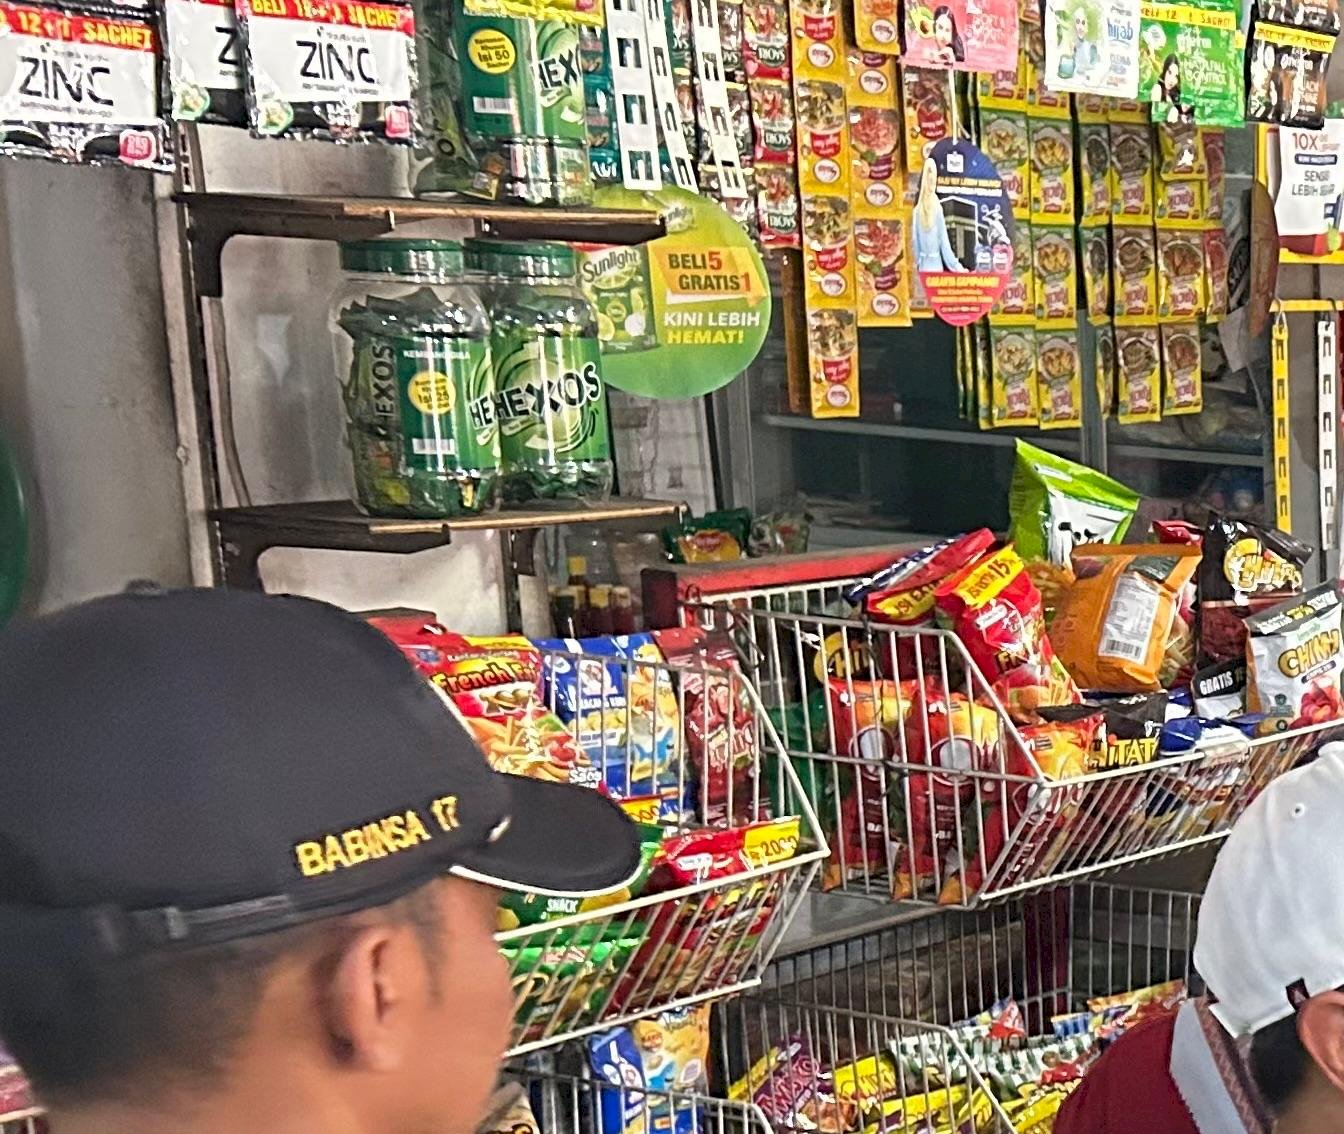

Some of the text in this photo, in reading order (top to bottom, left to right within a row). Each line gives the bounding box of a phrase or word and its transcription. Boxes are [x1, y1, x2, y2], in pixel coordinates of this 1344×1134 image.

[84, 25, 153, 50] SACHET
[296, 40, 376, 84] ZINC
[540, 48, 580, 92] HEX
[20, 56, 114, 106] ZINC
[581, 248, 641, 283] Sunlight
[679, 273, 740, 291] GRATIS
[664, 311, 760, 327] KINI LEBIH
[667, 329, 745, 344] HEMAT!
[499, 362, 601, 422] HEXOS
[432, 663, 508, 697] French
[1200, 671, 1234, 697] GRATIS
[296, 796, 462, 878] BABINSA 17
